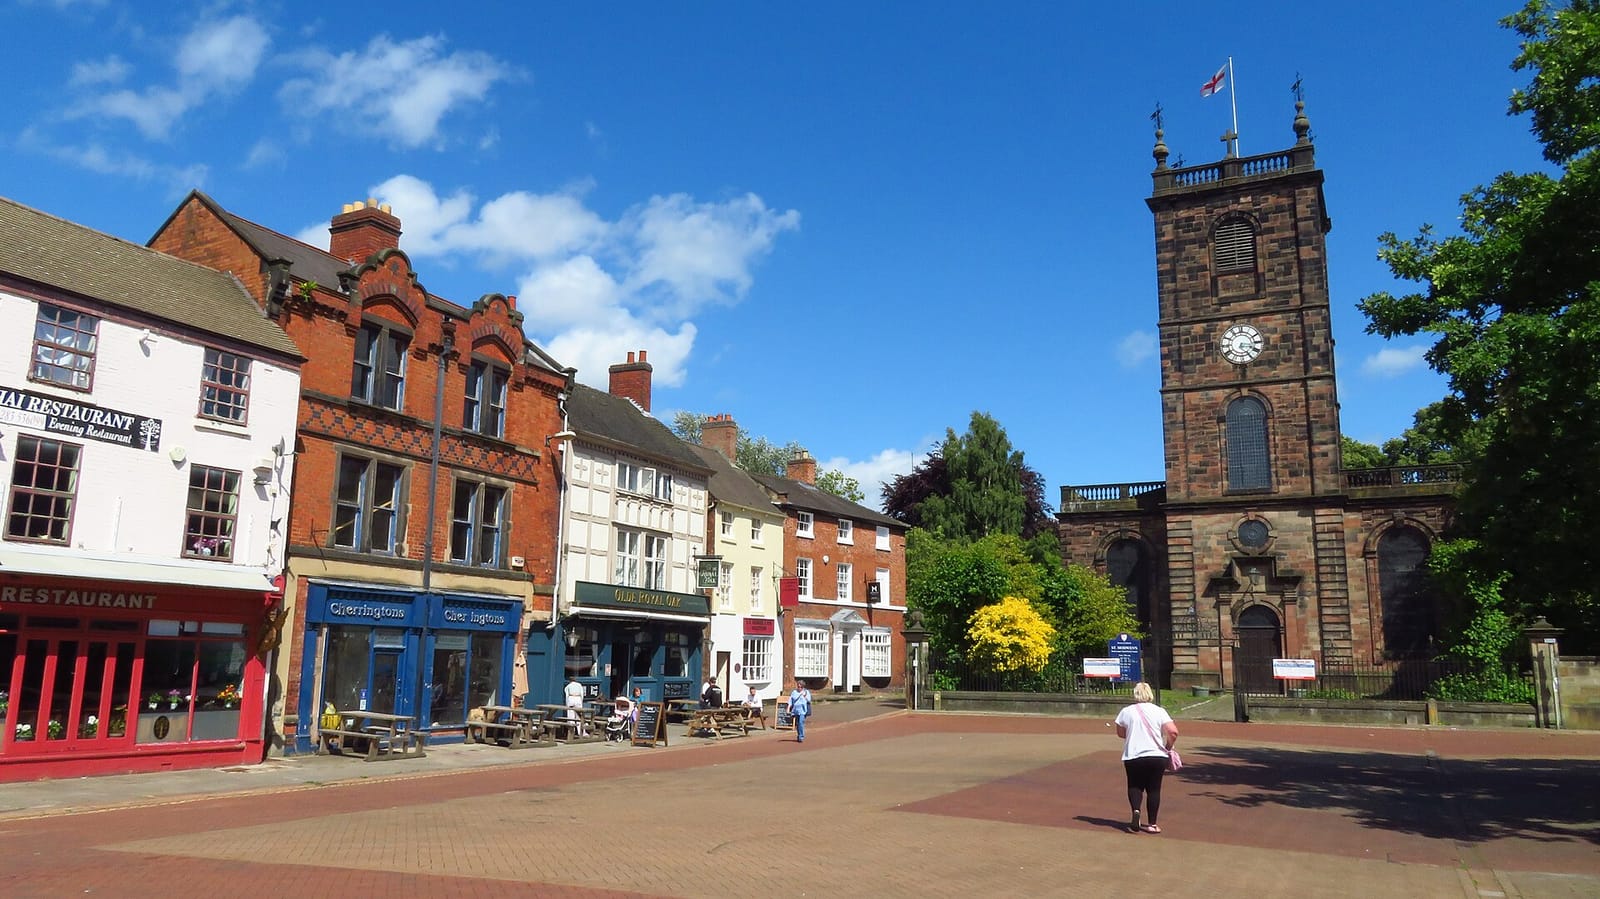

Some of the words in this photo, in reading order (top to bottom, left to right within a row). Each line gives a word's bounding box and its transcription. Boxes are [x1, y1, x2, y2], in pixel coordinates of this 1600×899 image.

[27, 395, 135, 431] RESTAURANT
[48, 418, 85, 437] Evening
[86, 425, 133, 444] Restaurant
[1, 586, 157, 609] RESTAURANT
[615, 589, 637, 603] OLDE
[638, 591, 665, 606] ROYAL
[666, 594, 681, 608] OAK
[330, 602, 406, 620] Cherringtons
